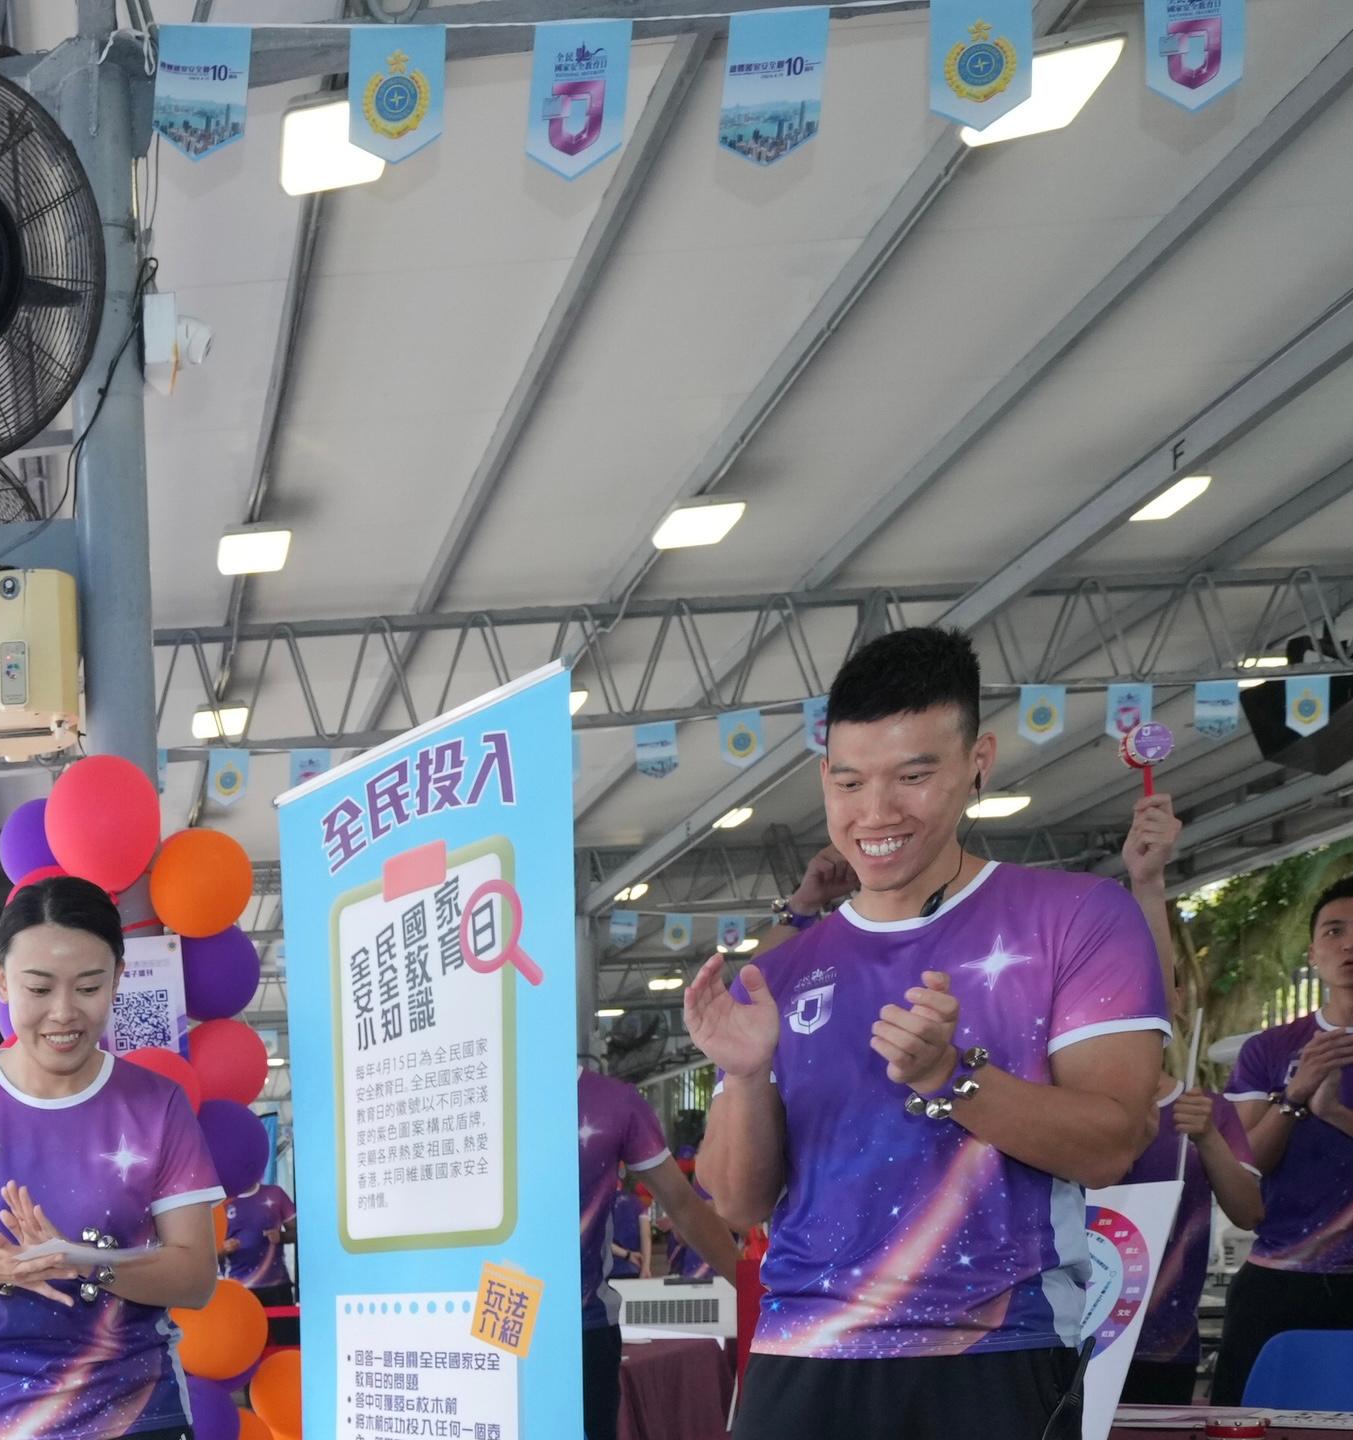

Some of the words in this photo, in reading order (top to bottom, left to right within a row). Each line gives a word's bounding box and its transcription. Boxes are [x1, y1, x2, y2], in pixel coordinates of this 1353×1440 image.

[209, 64, 228, 81] 10
[785, 56, 804, 76] 10
[1171, 439, 1186, 471] F
[322, 732, 516, 874] 全民投入
[357, 986, 436, 1051] 小知識
[355, 1038, 488, 1080] 每年4月15日為全民國家
[356, 1085, 489, 1124] 教育日的徽號以不同深淺
[484, 1280, 529, 1319] 玩法
[479, 1309, 523, 1348] 介紹
[355, 1350, 500, 1371] 回答一題有關全民國家安全
[355, 1371, 419, 1391] 教育日的問題
